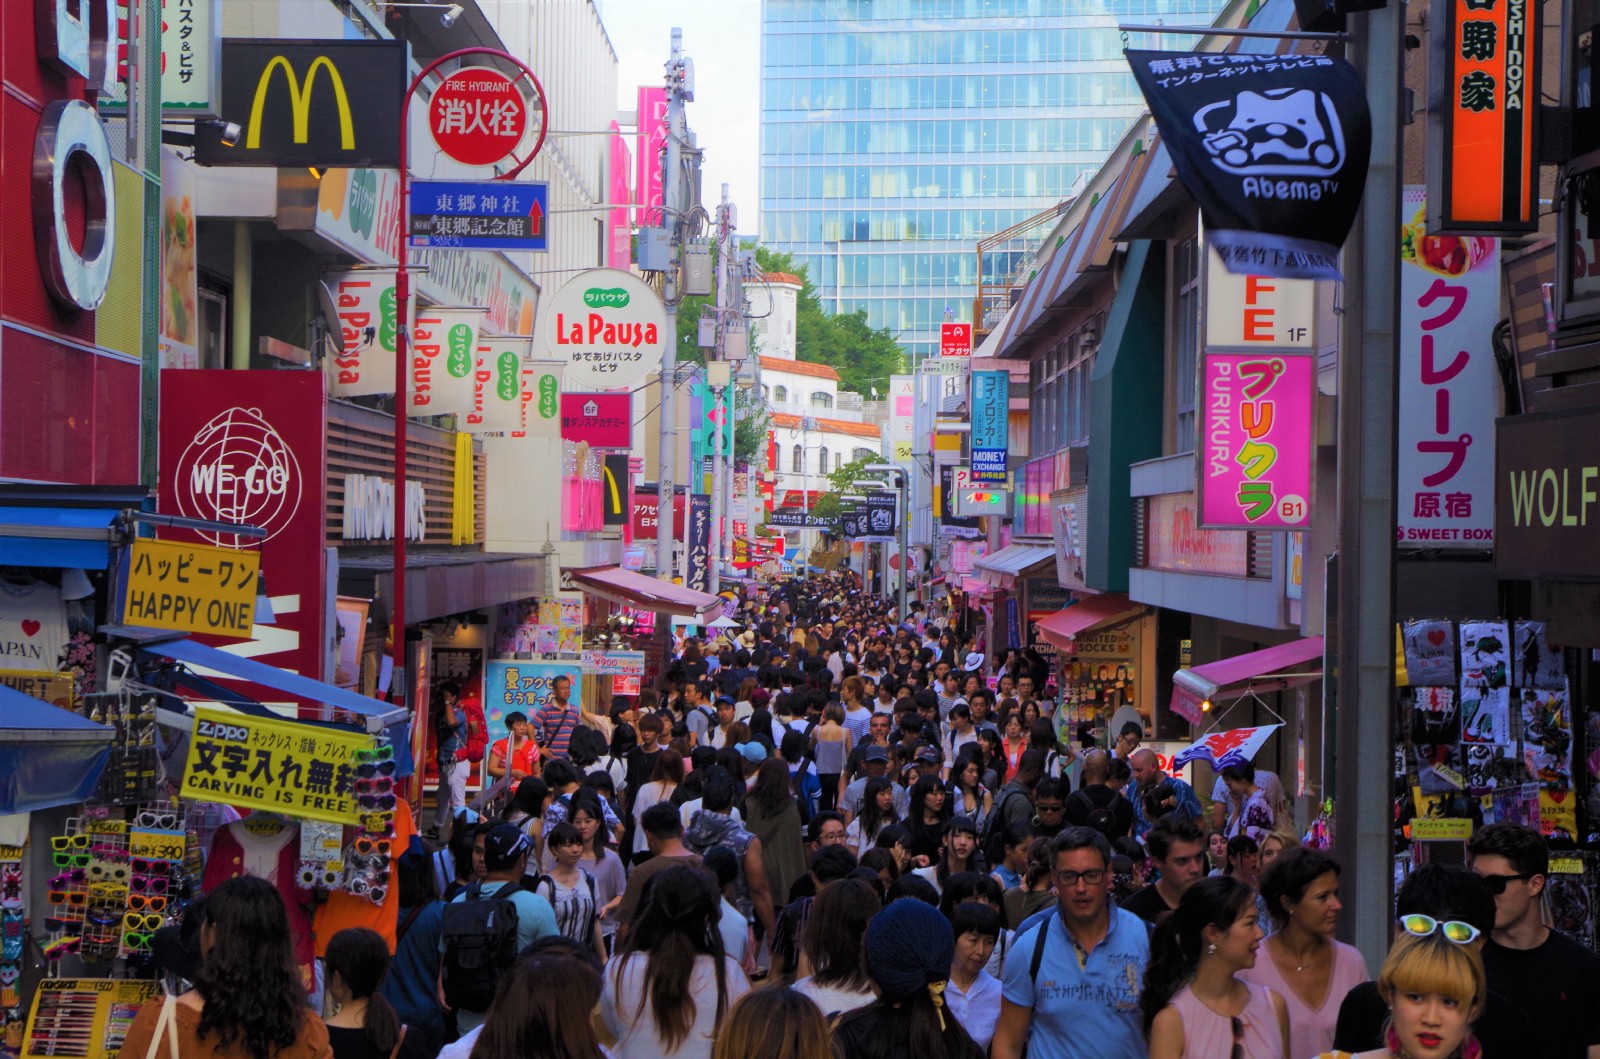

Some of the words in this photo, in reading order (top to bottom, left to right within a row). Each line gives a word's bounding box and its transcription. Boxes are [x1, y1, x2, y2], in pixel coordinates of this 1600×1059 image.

[446, 81, 466, 92] FIRE
[469, 81, 511, 93] HYDRANT
[437, 98, 519, 137] 消火栓
[435, 194, 520, 214] 東郷神社
[435, 217, 525, 237] 東郷記念館
[585, 292, 629, 303] ラパウザ
[1287, 328, 1307, 342] 1F
[572, 351, 643, 362] ゆであげパスタ
[1416, 278, 1473, 487] クレープ
[585, 406, 597, 414] 6F
[985, 376, 996, 446] コインロッカー
[1210, 361, 1232, 479] PURIKURA
[1235, 357, 1287, 523] プリクラ
[973, 451, 1006, 462] MONEY
[972, 463, 1006, 471] EXCHANGE
[1413, 492, 1473, 518] 原宿
[1509, 466, 1599, 527] WOLF
[634, 505, 678, 515] アクセー
[1282, 502, 1303, 517] B1
[1407, 528, 1460, 541] SWEET
[1463, 528, 1493, 541] BOX
[134, 552, 255, 591] ハッピーワン
[129, 590, 202, 624] HAPPY
[207, 599, 250, 630] ONE
[1079, 643, 1115, 652] SOCKS
[188, 775, 265, 799] CARVING
[275, 790, 293, 804] IS
